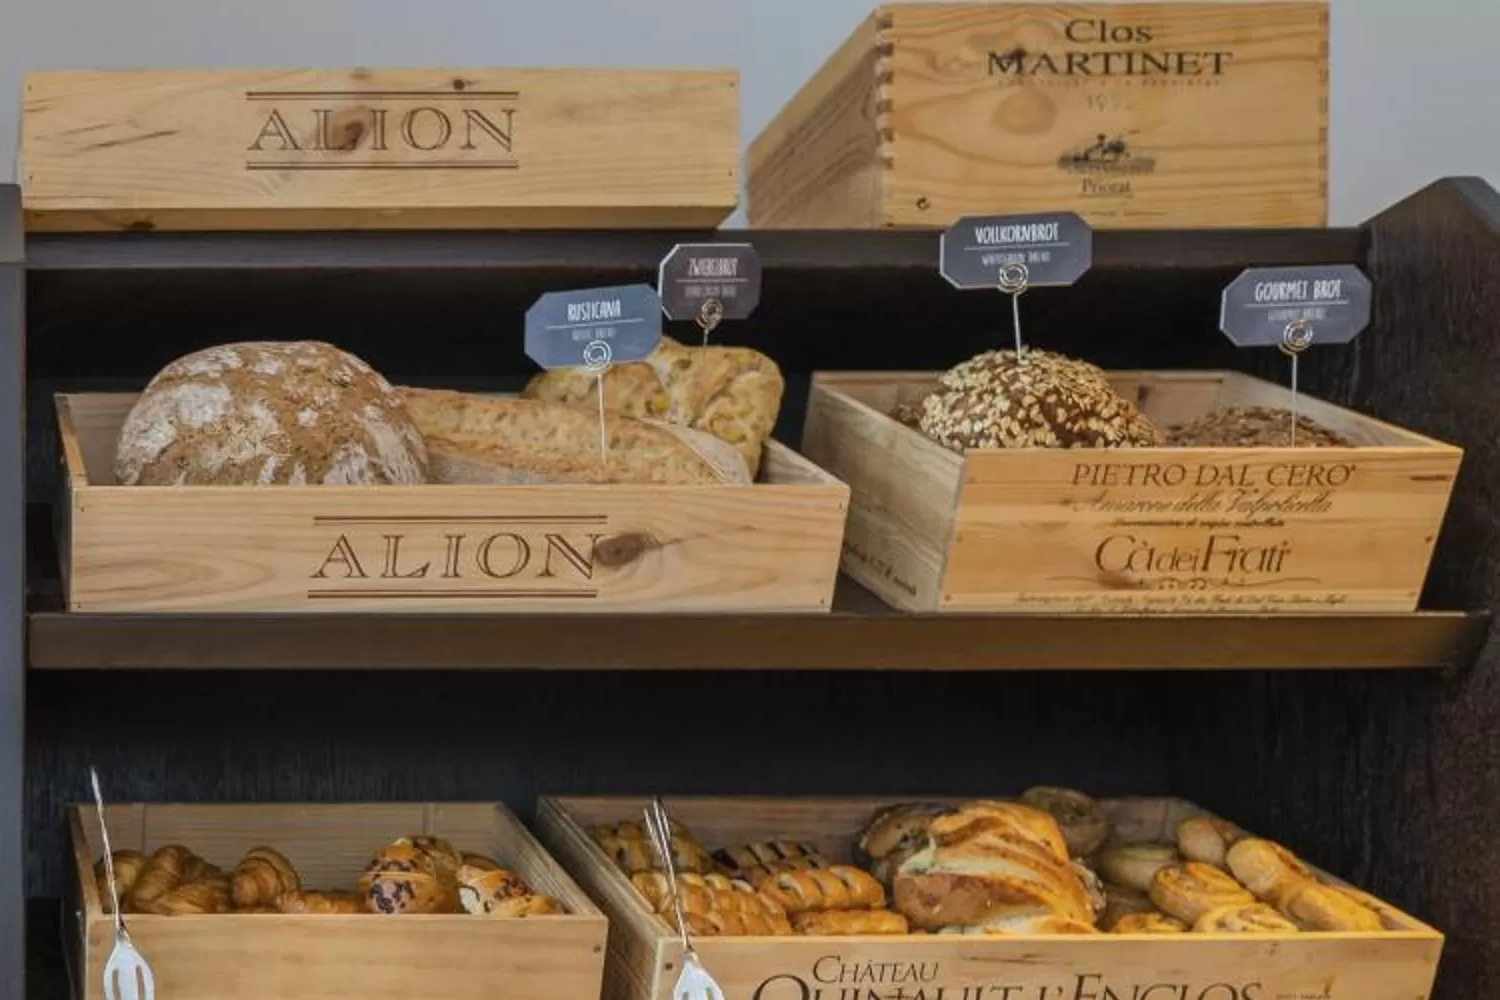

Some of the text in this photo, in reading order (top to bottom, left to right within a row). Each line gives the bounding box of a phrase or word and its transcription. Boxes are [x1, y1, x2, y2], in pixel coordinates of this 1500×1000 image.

[1065, 19, 1155, 44] Clos
[986, 50, 1234, 76] MARTINET
[246, 106, 517, 152] ALION
[974, 221, 1060, 245] VOLLKORNBROT
[1255, 279, 1342, 302] GOURMET BROT
[1072, 463, 1187, 487] PIETRO
[1195, 463, 1257, 486] DAL
[308, 531, 606, 581] ALION
